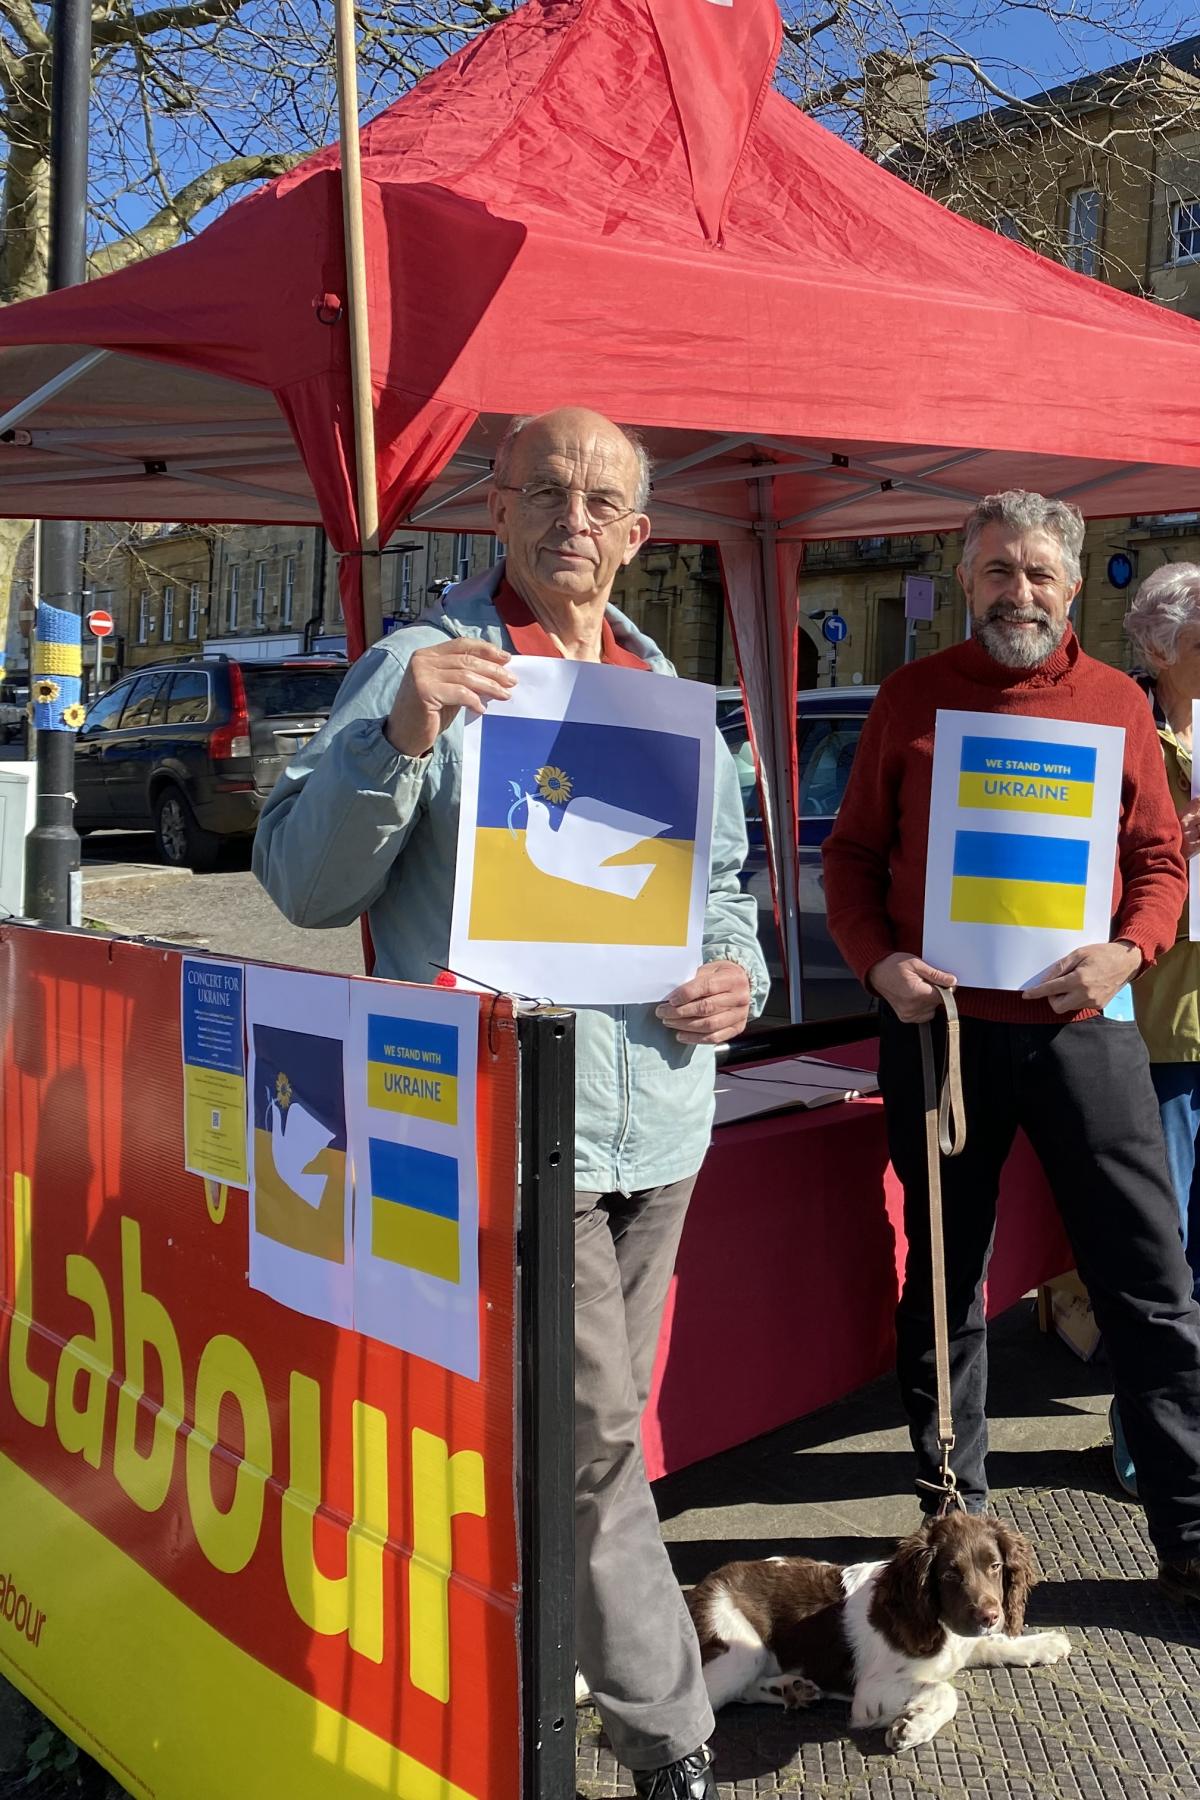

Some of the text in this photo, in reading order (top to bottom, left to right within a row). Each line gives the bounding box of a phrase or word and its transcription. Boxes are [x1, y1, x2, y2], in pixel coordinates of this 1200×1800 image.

[985, 758, 1072, 775] WE STAND WITH
[984, 779, 1071, 802] UKRAINE
[187, 969, 240, 992] CONCERT FOR
[197, 987, 231, 1007] UKRAINE
[383, 1044, 442, 1065] WE STAND WITH
[383, 1071, 442, 1103] UKRAINE
[8, 1171, 486, 1704] Labour
